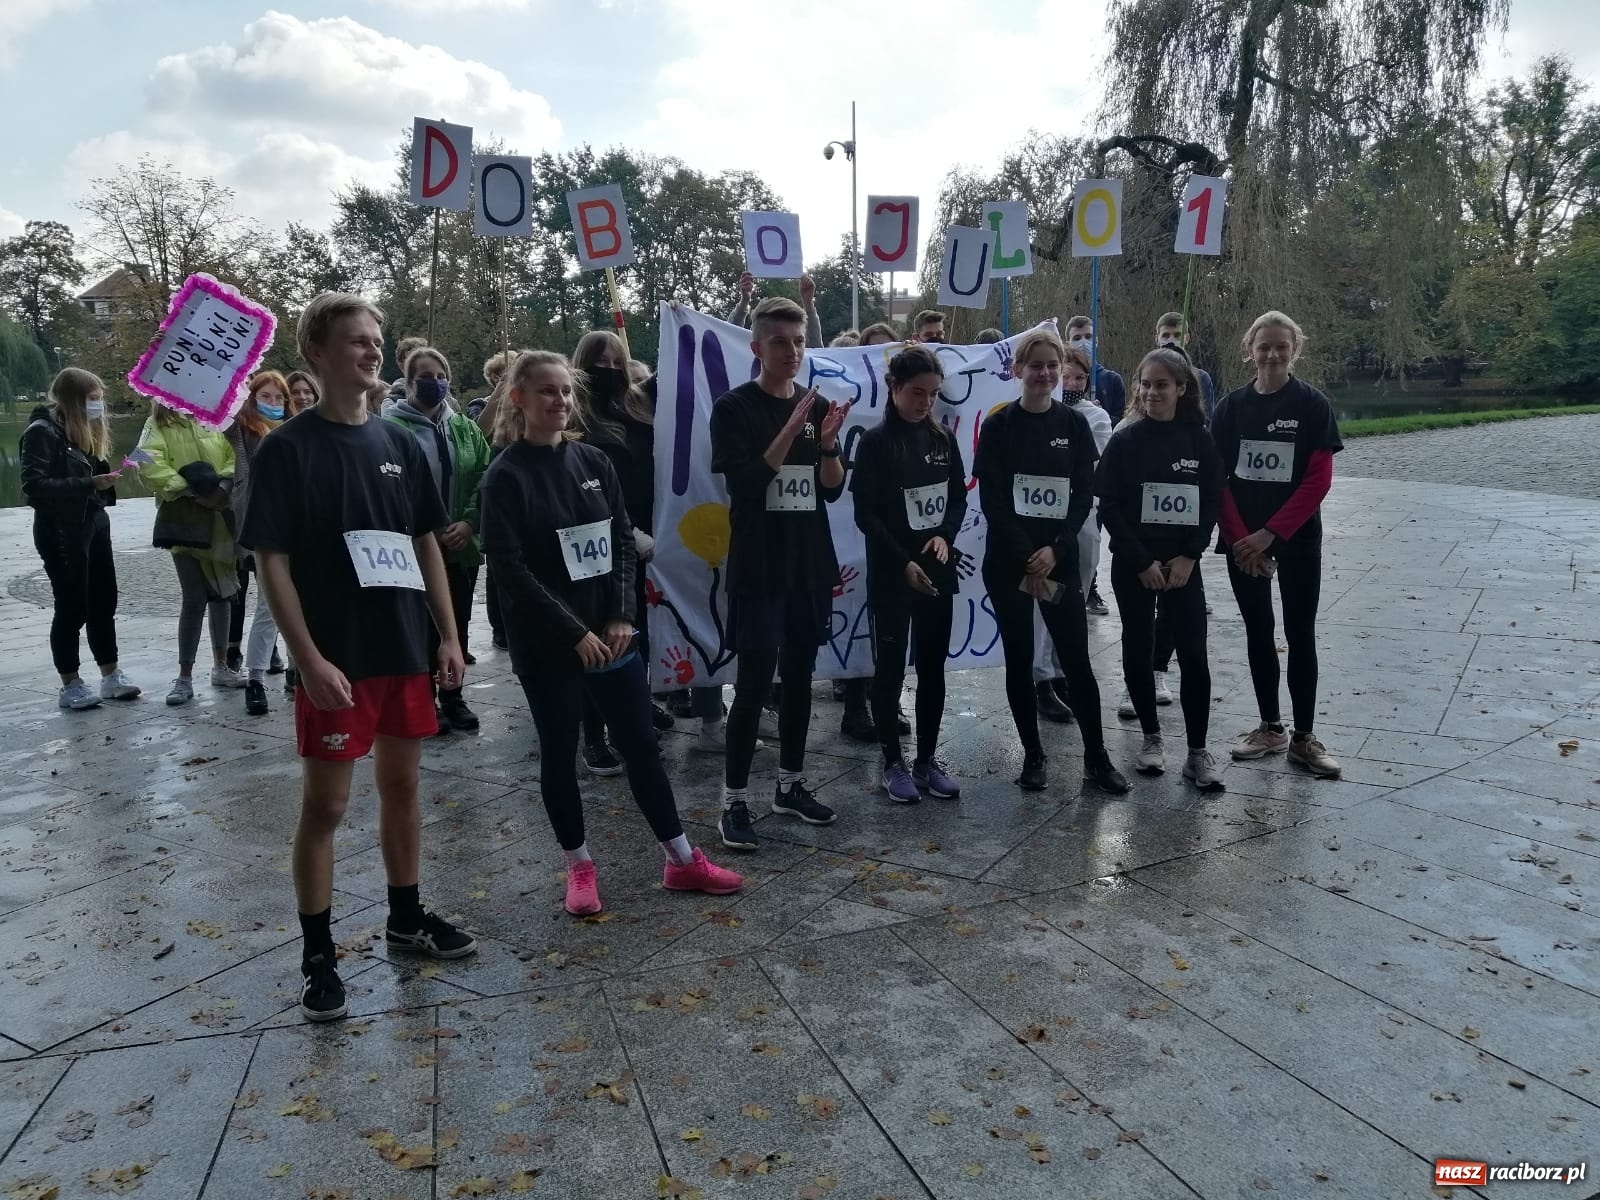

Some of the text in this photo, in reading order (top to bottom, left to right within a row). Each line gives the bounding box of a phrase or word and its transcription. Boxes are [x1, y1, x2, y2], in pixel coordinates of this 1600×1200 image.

[422, 125, 459, 198] D
[481, 162, 525, 227] O
[1187, 187, 1213, 246] 1
[577, 198, 622, 260] B
[871, 202, 910, 262] J
[987, 211, 1026, 269] L
[948, 239, 988, 296] U
[162, 327, 200, 376] RUN!
[190, 311, 233, 367] RUN!
[216, 316, 254, 362] RUN!
[775, 478, 810, 497] 140
[915, 495, 945, 517] 160
[571, 536, 608, 563] 140
